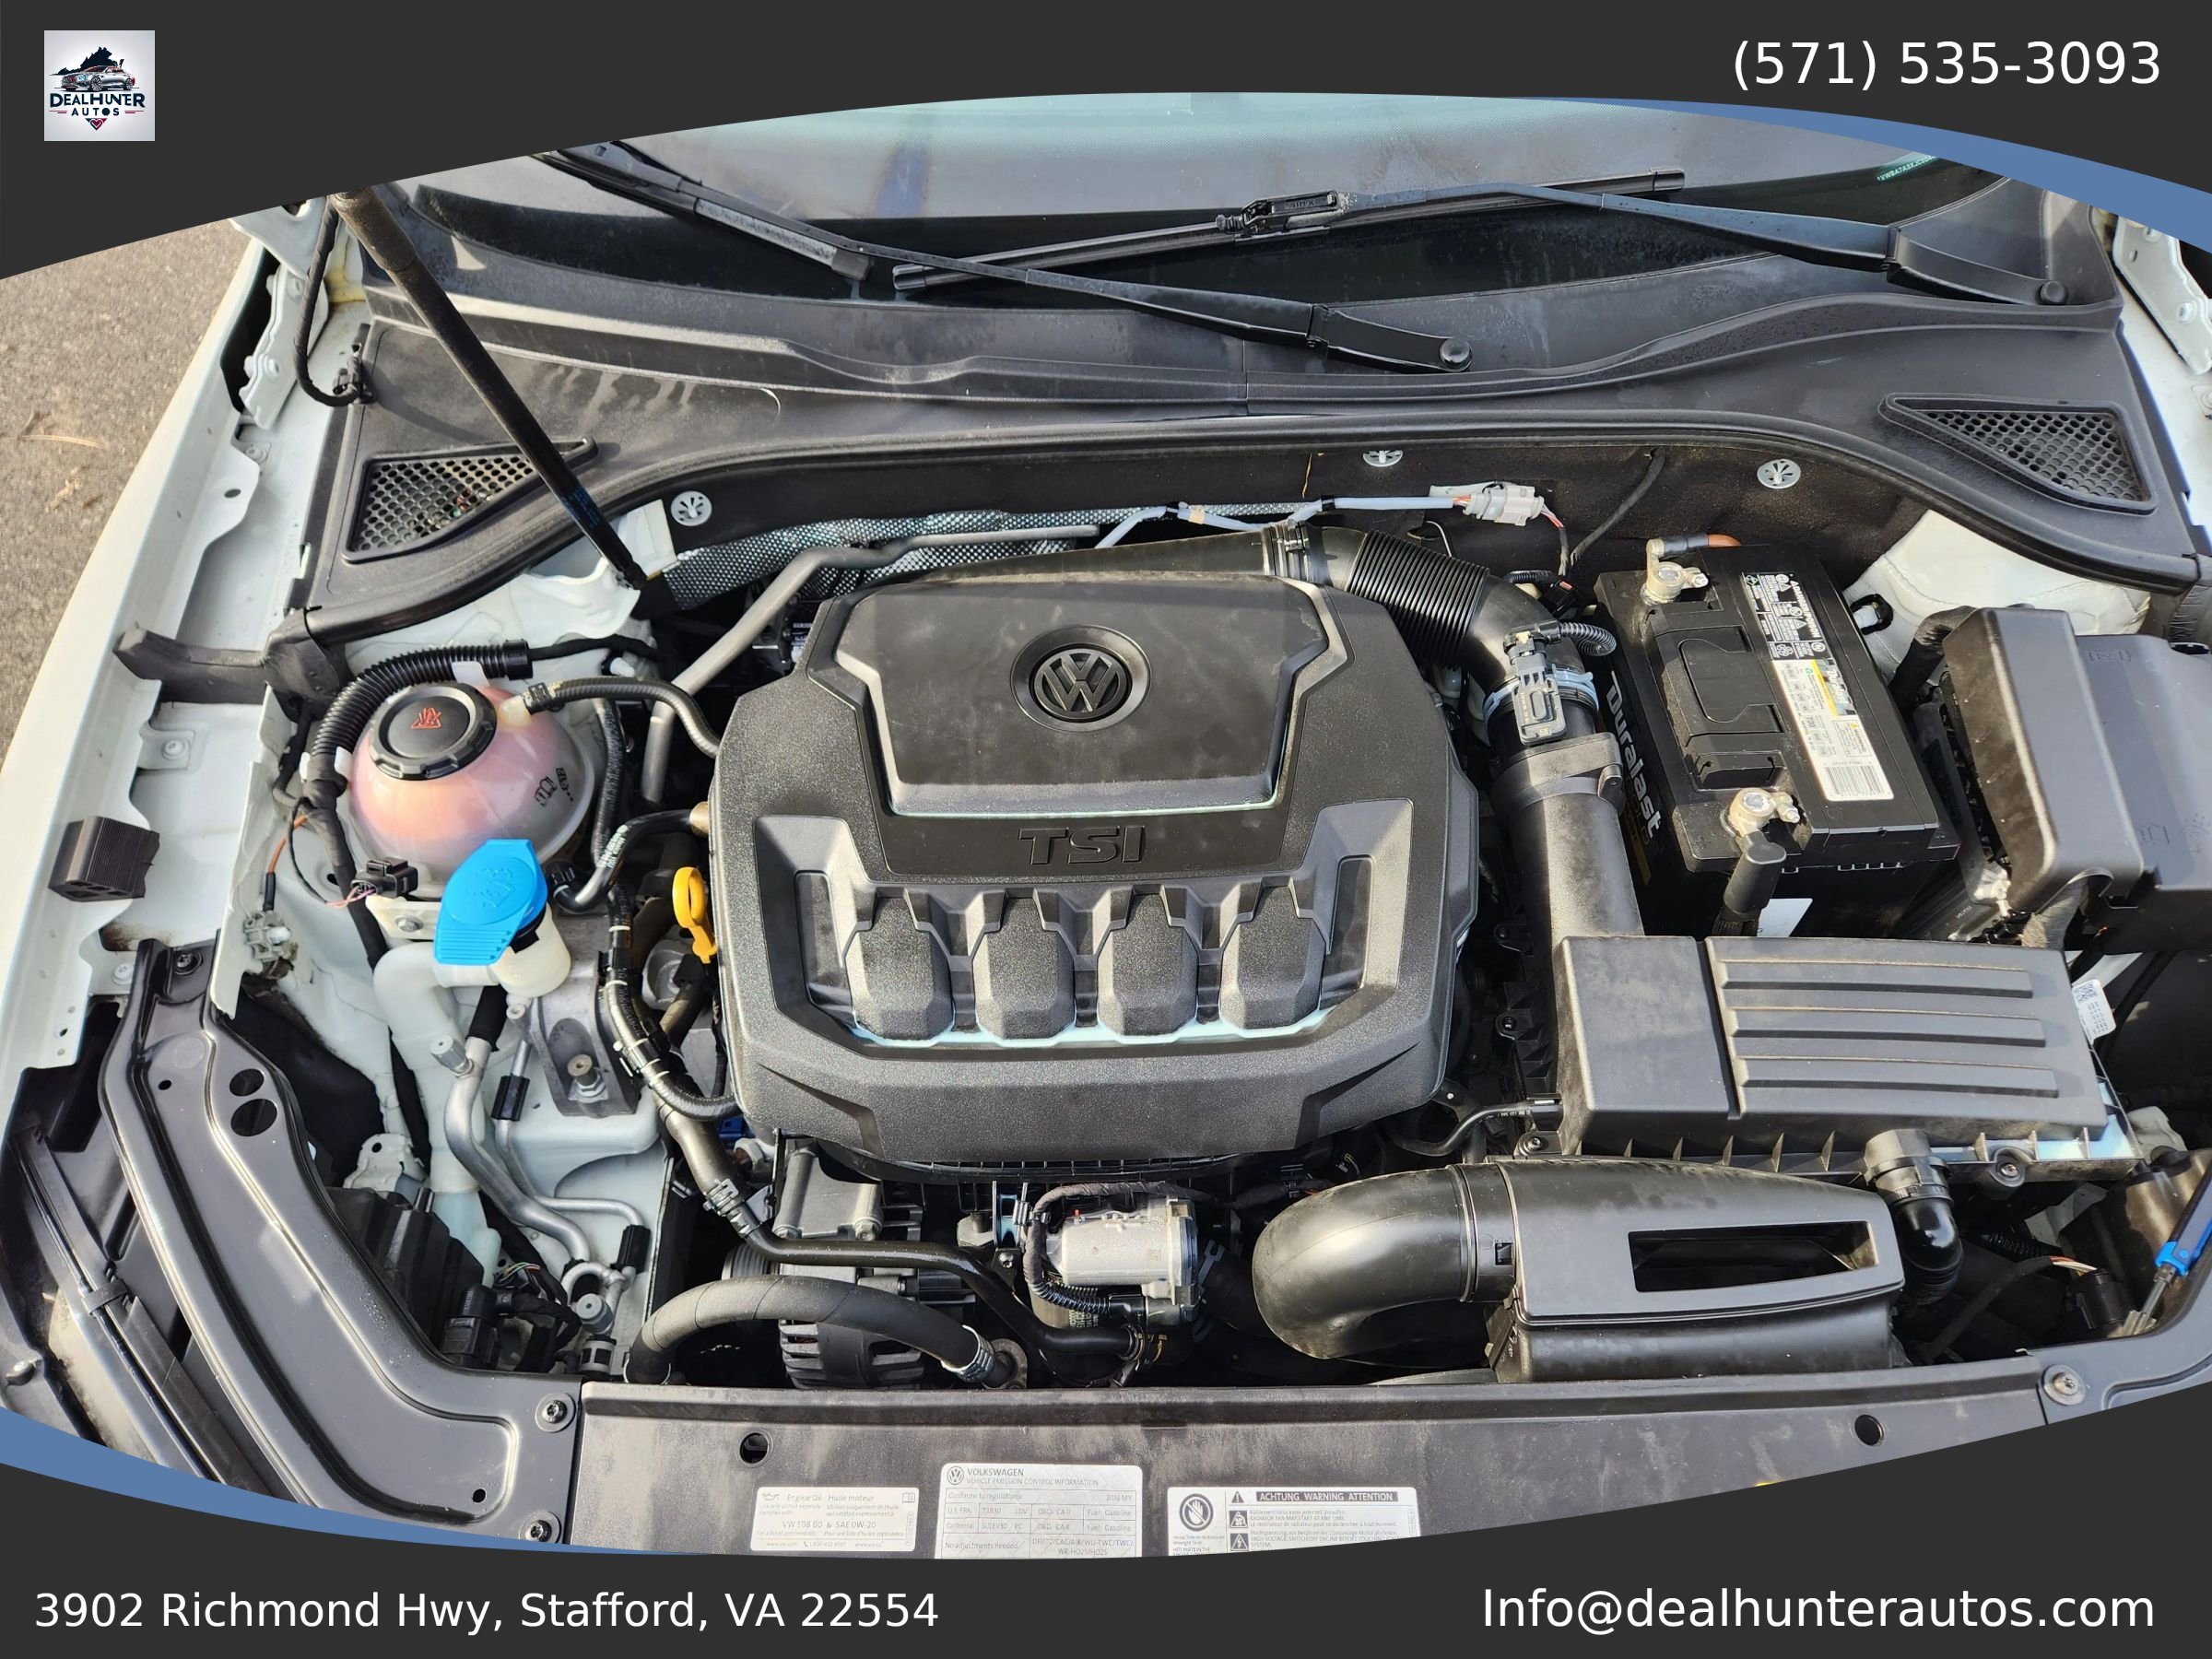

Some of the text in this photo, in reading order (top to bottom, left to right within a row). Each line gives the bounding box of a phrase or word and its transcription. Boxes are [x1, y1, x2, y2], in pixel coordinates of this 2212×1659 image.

[1792, 585, 1822, 638] DANGER/POISON
[1606, 670, 1661, 839] Duralast
[1018, 826, 1143, 865] TSI
[787, 1494, 811, 1502] Engine
[1259, 1492, 1393, 1501] ACHTUNG WARNING ATTENTION
[955, 1541, 993, 1550] adjustments
